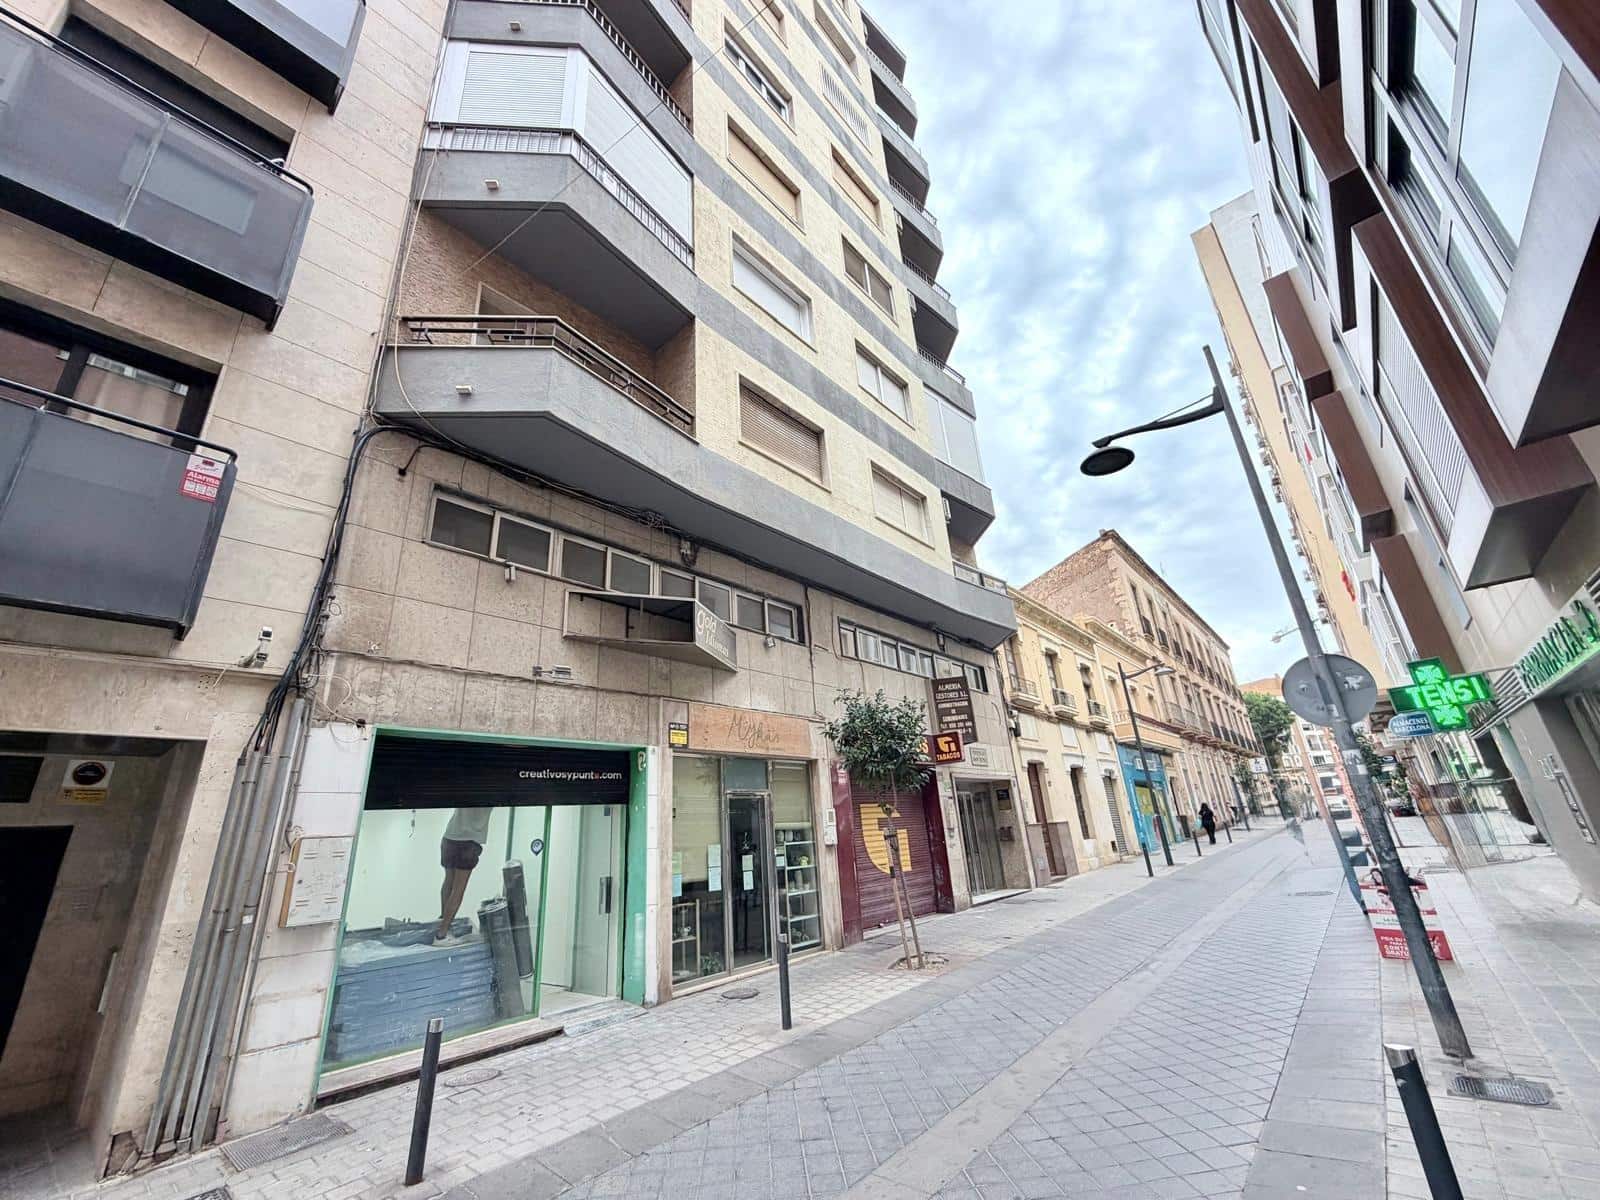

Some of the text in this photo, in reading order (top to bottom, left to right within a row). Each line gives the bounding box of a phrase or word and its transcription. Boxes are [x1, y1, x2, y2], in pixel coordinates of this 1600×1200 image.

[1517, 617, 1587, 695] FARMACIA
[1405, 676, 1485, 708] TENSI
[936, 752, 961, 761] TABACOS
